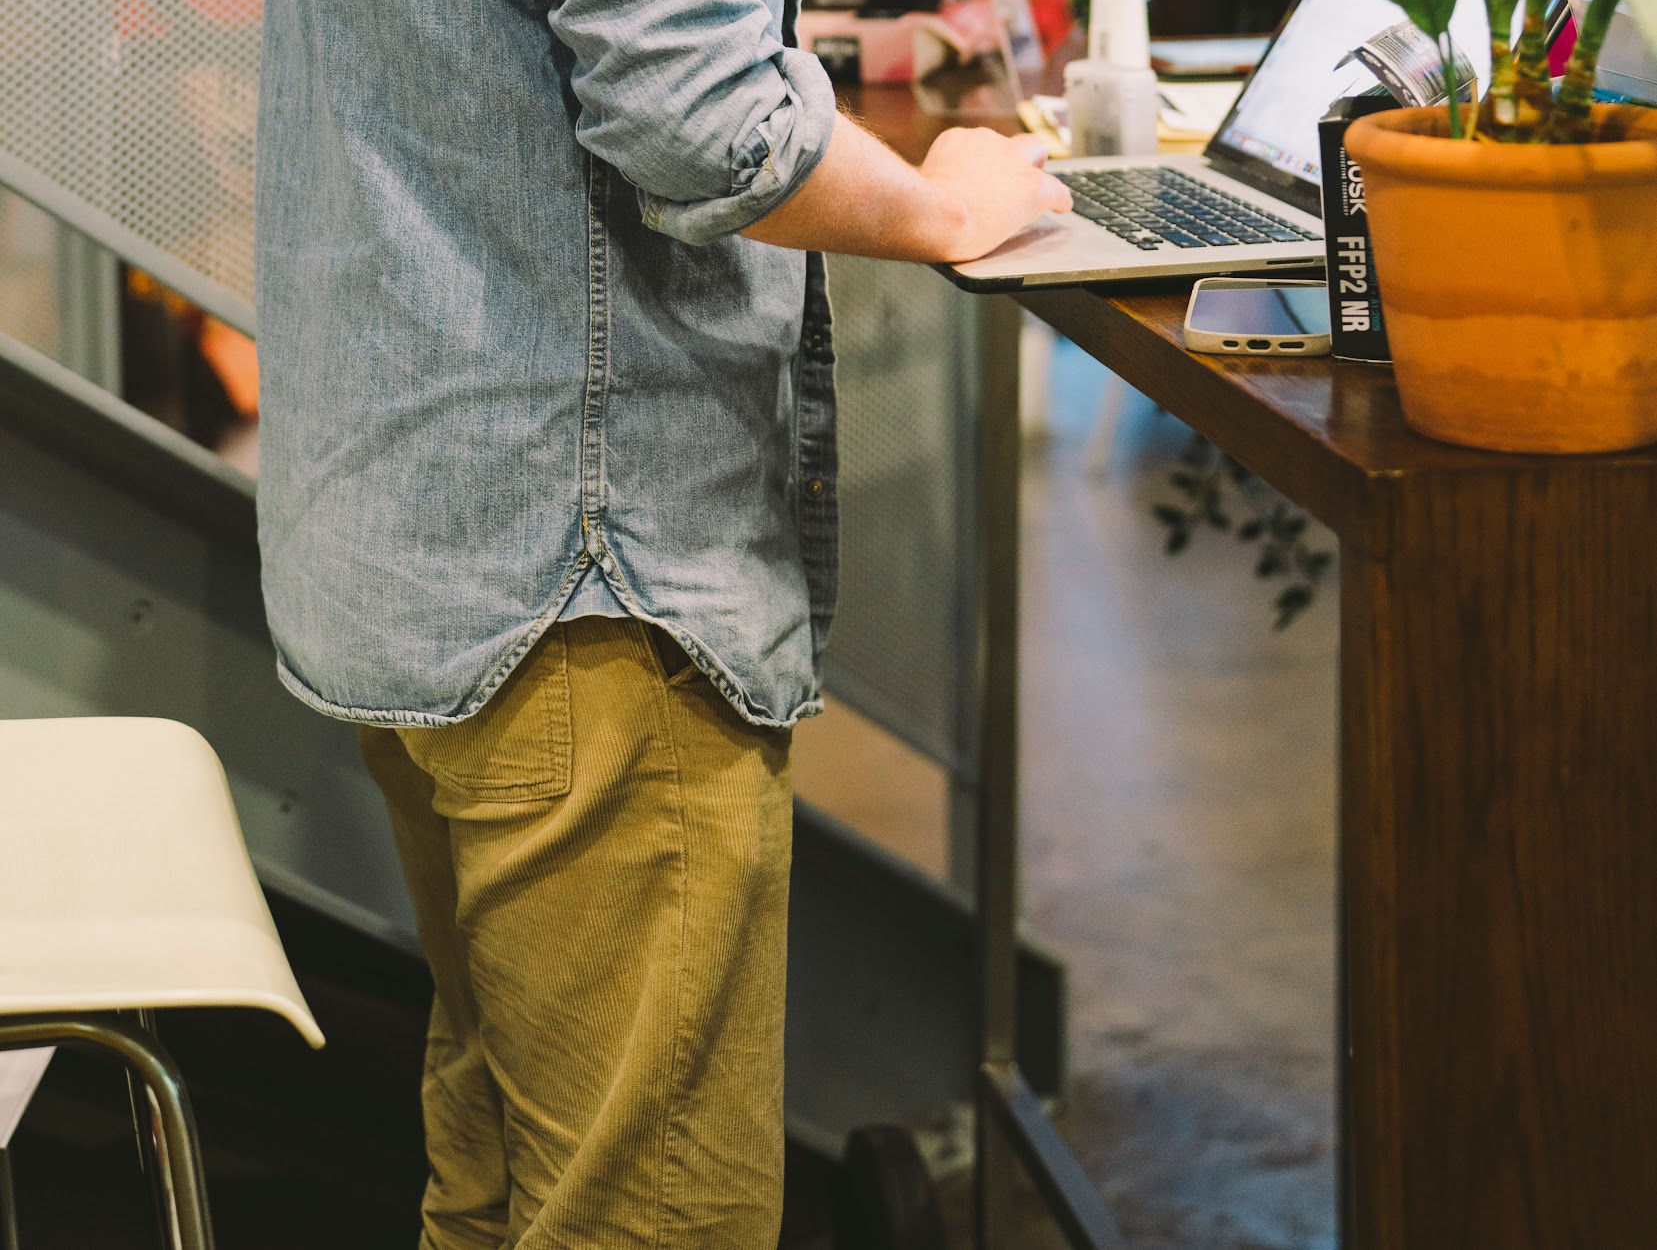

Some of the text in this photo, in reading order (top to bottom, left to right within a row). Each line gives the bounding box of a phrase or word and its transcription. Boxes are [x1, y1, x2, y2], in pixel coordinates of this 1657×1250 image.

[1347, 160, 1368, 216] USK
[1337, 236, 1370, 331] FFP2 NR
